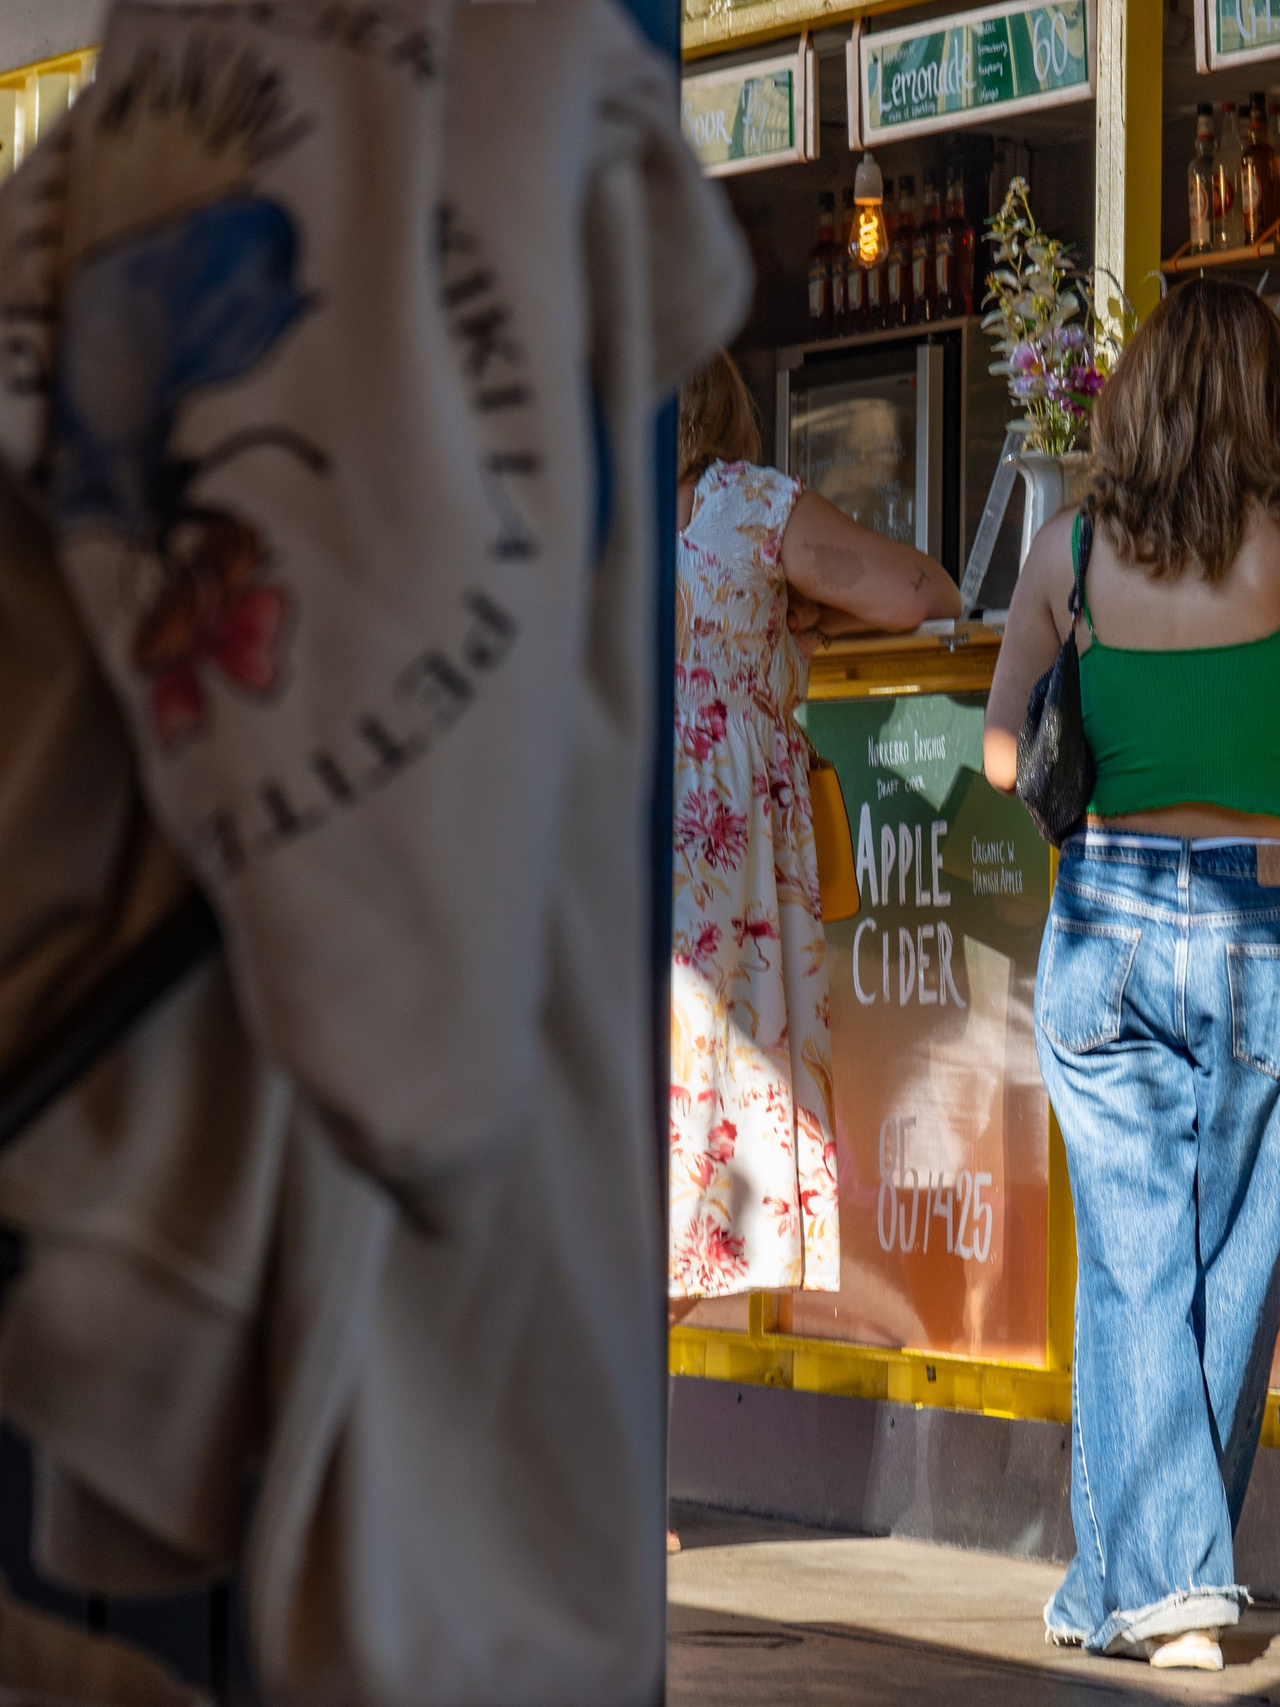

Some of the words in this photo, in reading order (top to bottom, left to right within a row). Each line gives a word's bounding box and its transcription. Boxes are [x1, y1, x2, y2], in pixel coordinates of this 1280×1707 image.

[877, 37, 977, 117] Lemonade
[1033, 12, 1067, 82] 60
[876, 778, 899, 800] DRAFT
[856, 801, 951, 908] APPLE
[971, 835, 1005, 865] ORGANIC
[972, 867, 999, 896] DANISH
[1000, 866, 1024, 895] APPLES
[852, 916, 967, 1010] CIDER
